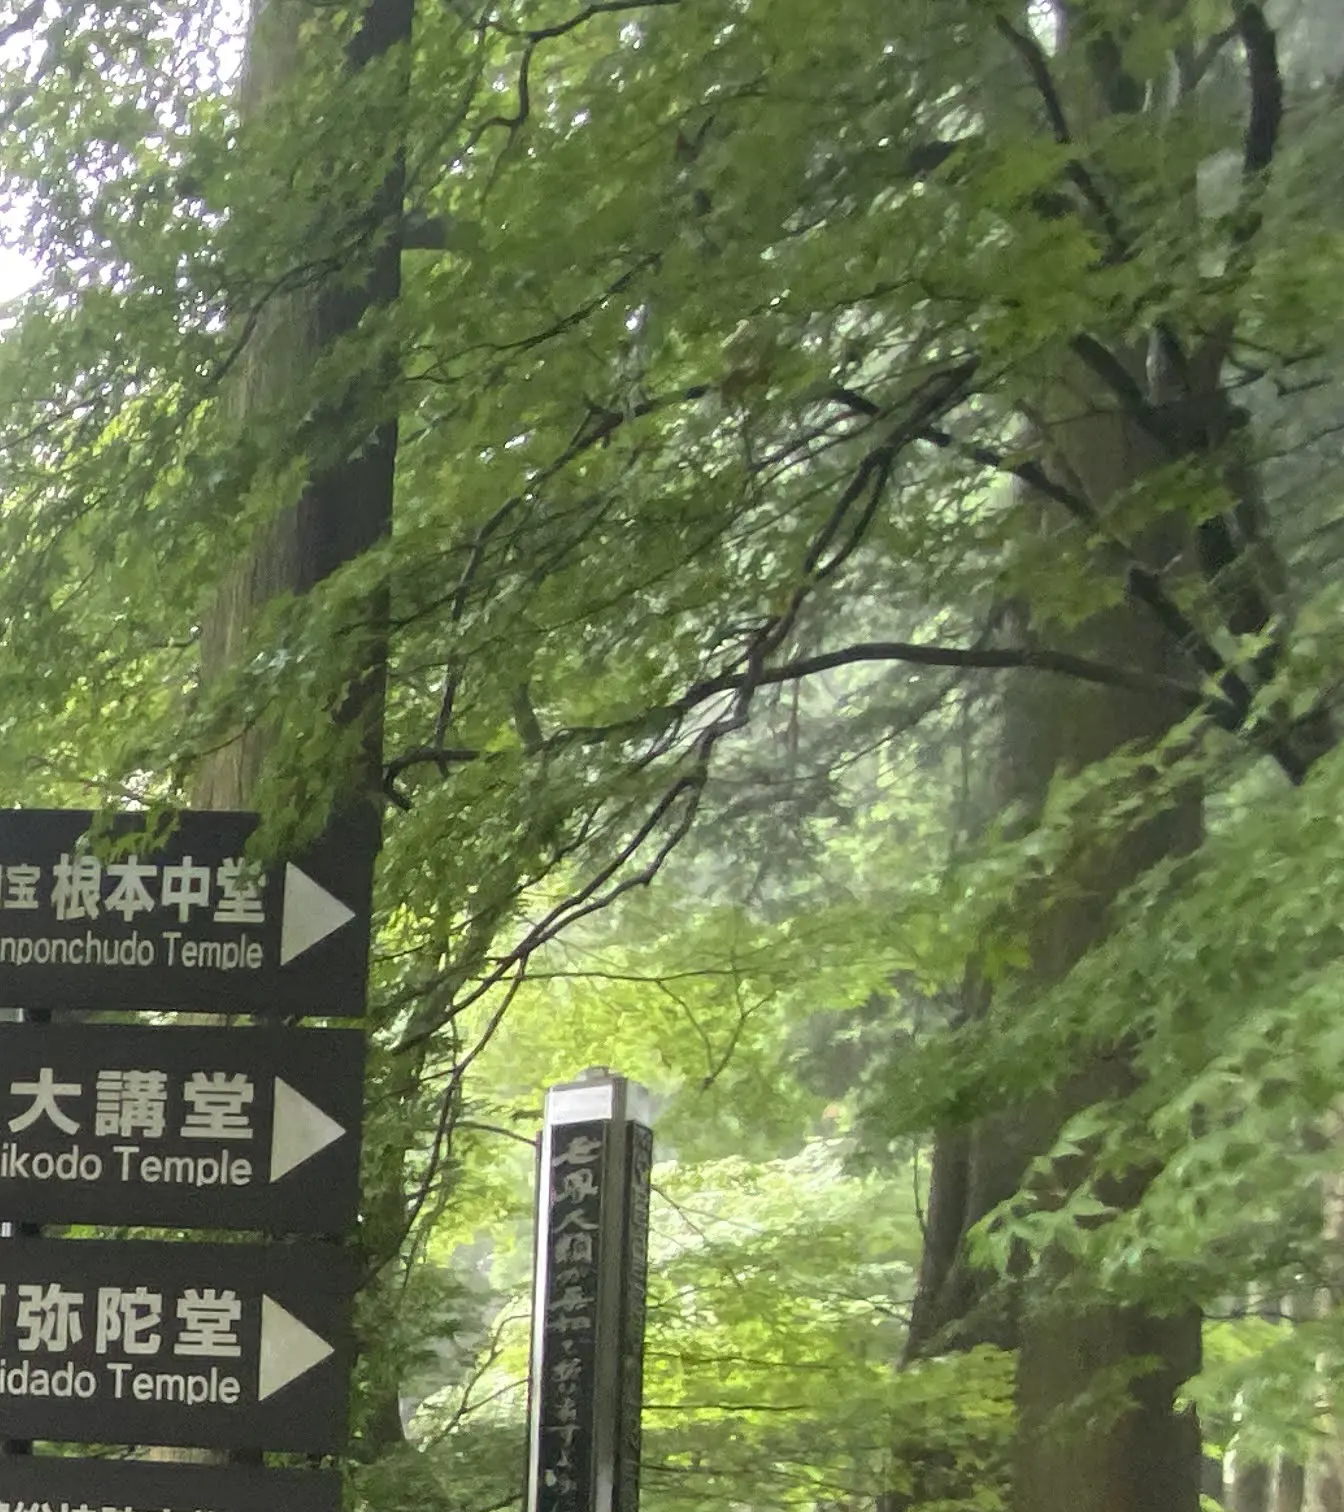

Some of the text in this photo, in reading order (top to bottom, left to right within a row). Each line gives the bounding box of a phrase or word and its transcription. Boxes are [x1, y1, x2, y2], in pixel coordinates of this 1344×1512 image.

[51, 853, 267, 923] 根本中堂
[162, 931, 264, 970] Temple
[8, 1068, 255, 1139] 大講堂
[112, 1145, 253, 1187] Temple
[106, 1362, 241, 1405] Temple
